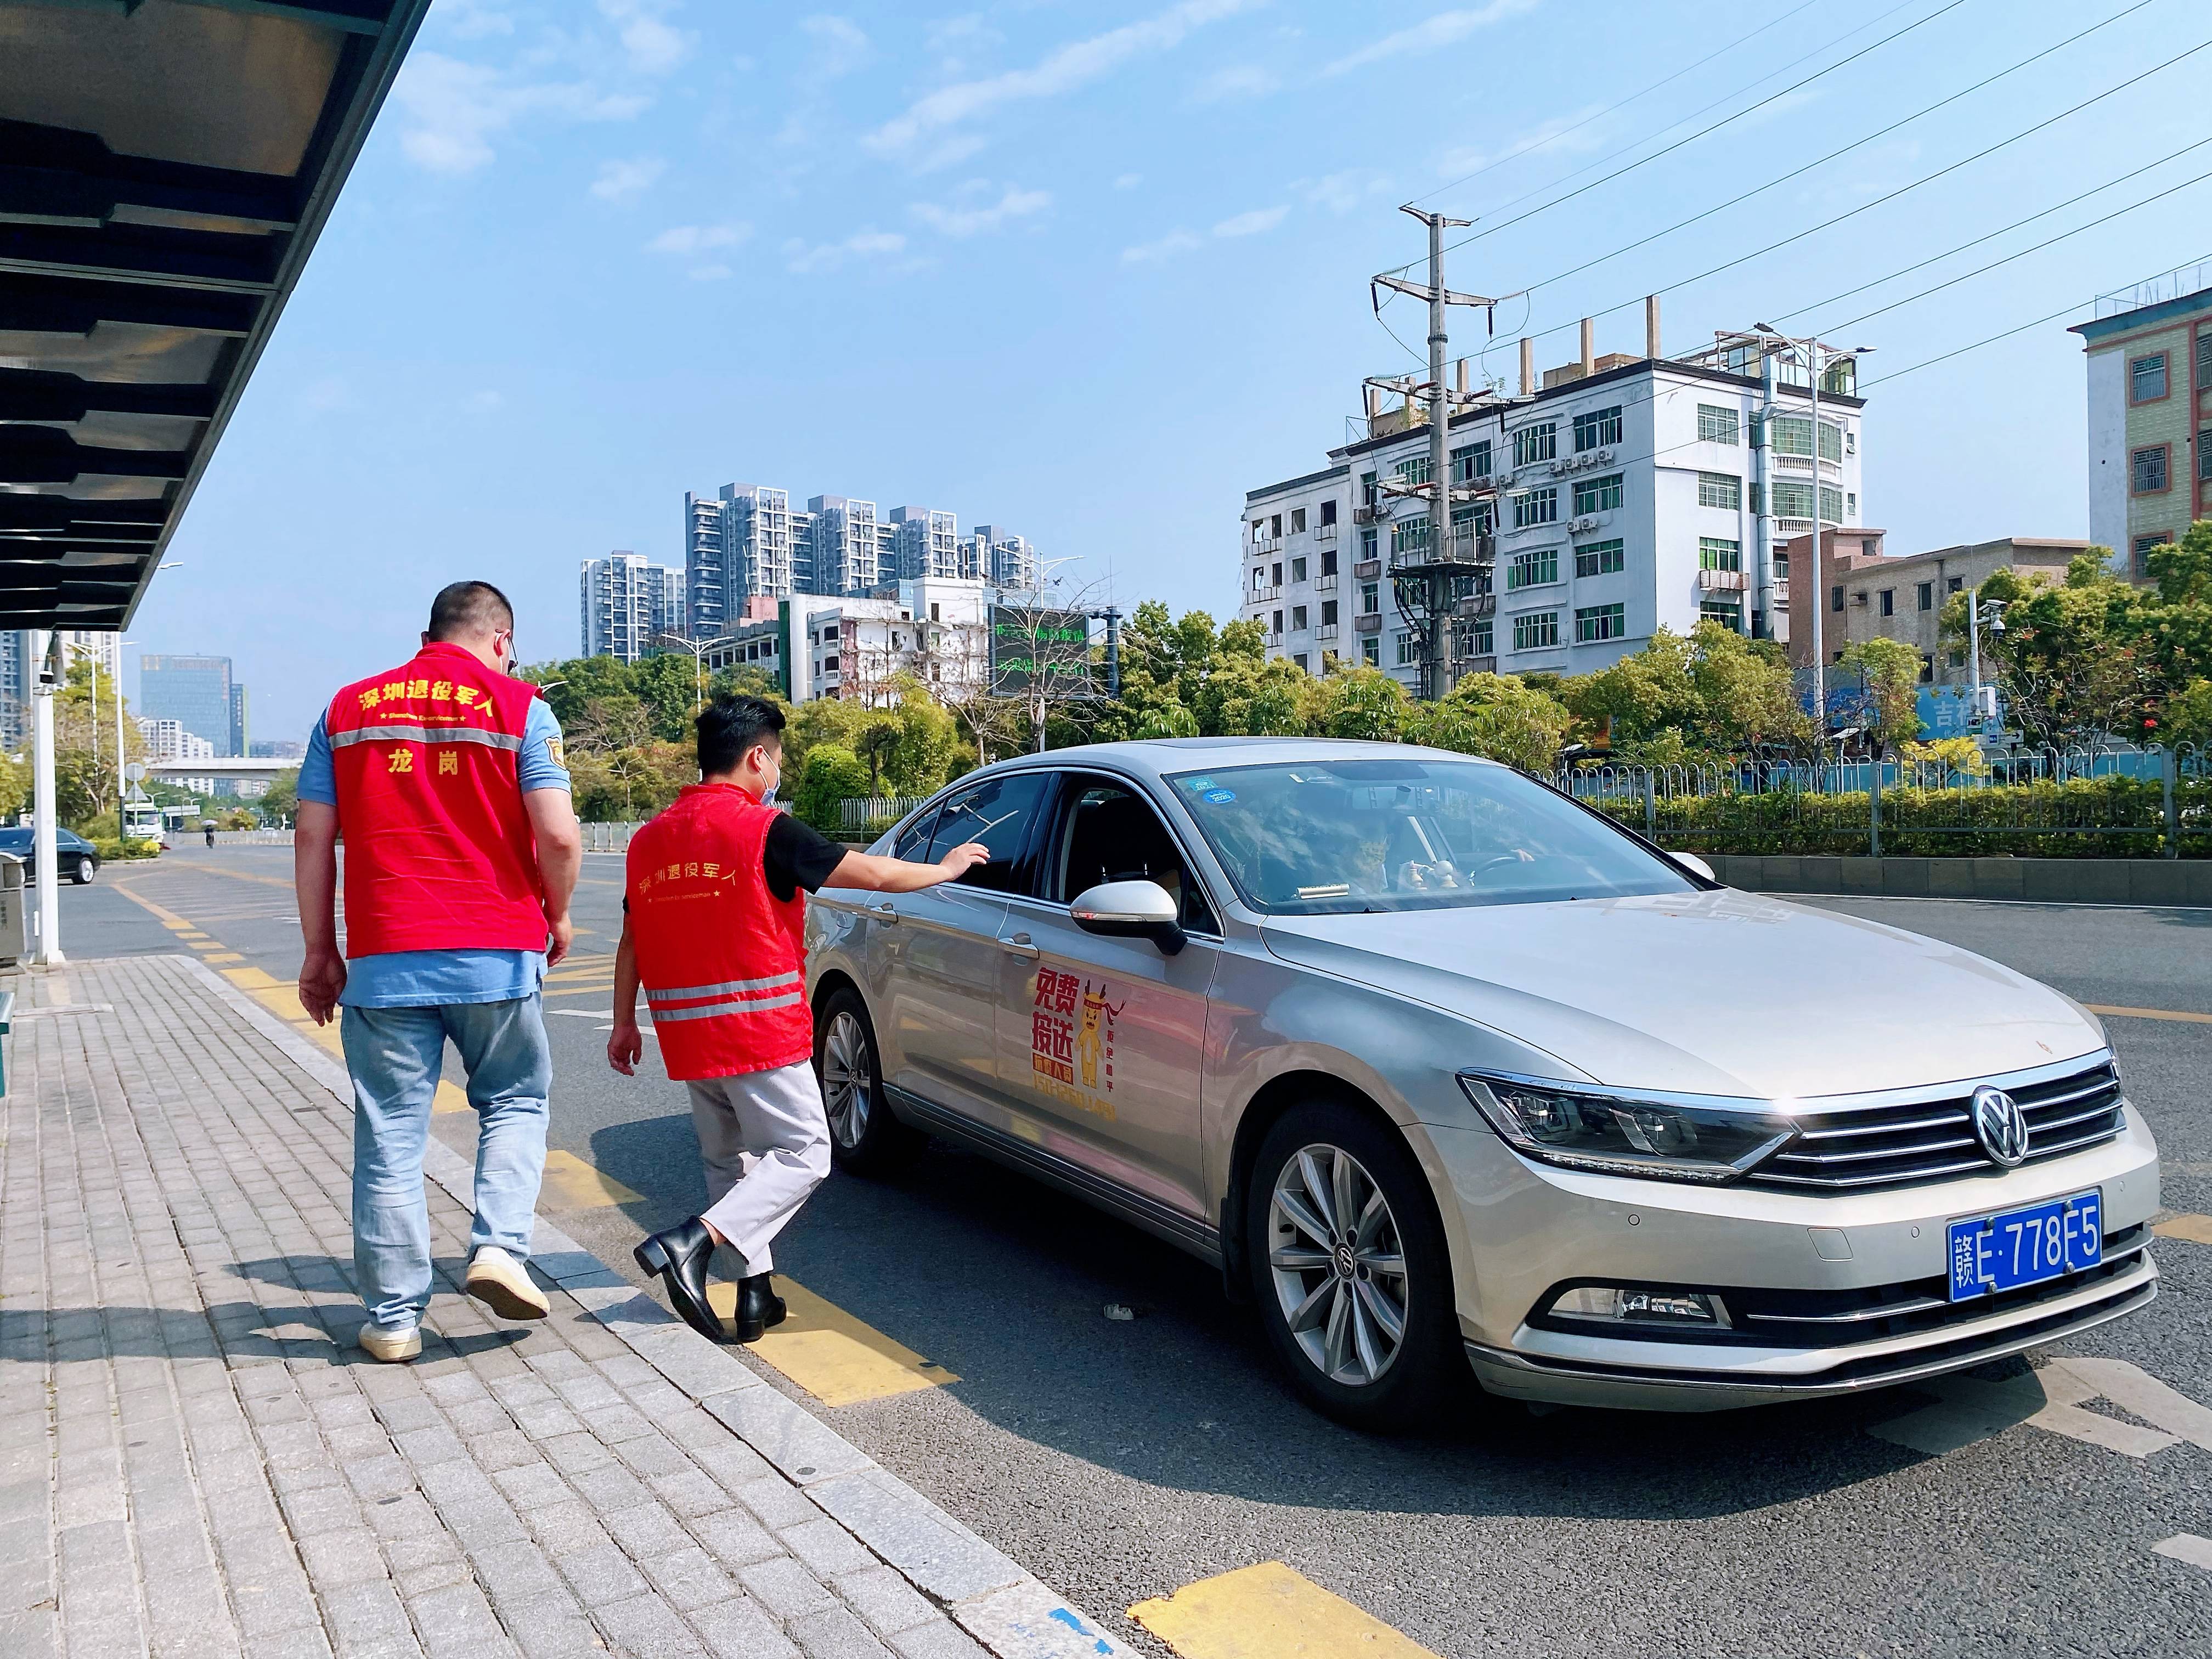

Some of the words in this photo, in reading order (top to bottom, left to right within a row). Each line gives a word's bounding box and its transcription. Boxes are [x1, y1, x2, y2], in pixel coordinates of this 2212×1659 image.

[358, 680, 493, 717] 深圳退役军人
[388, 748, 458, 775] 龙岗
[1035, 967, 1080, 1018] 免费
[1031, 1012, 1073, 1064] 接送
